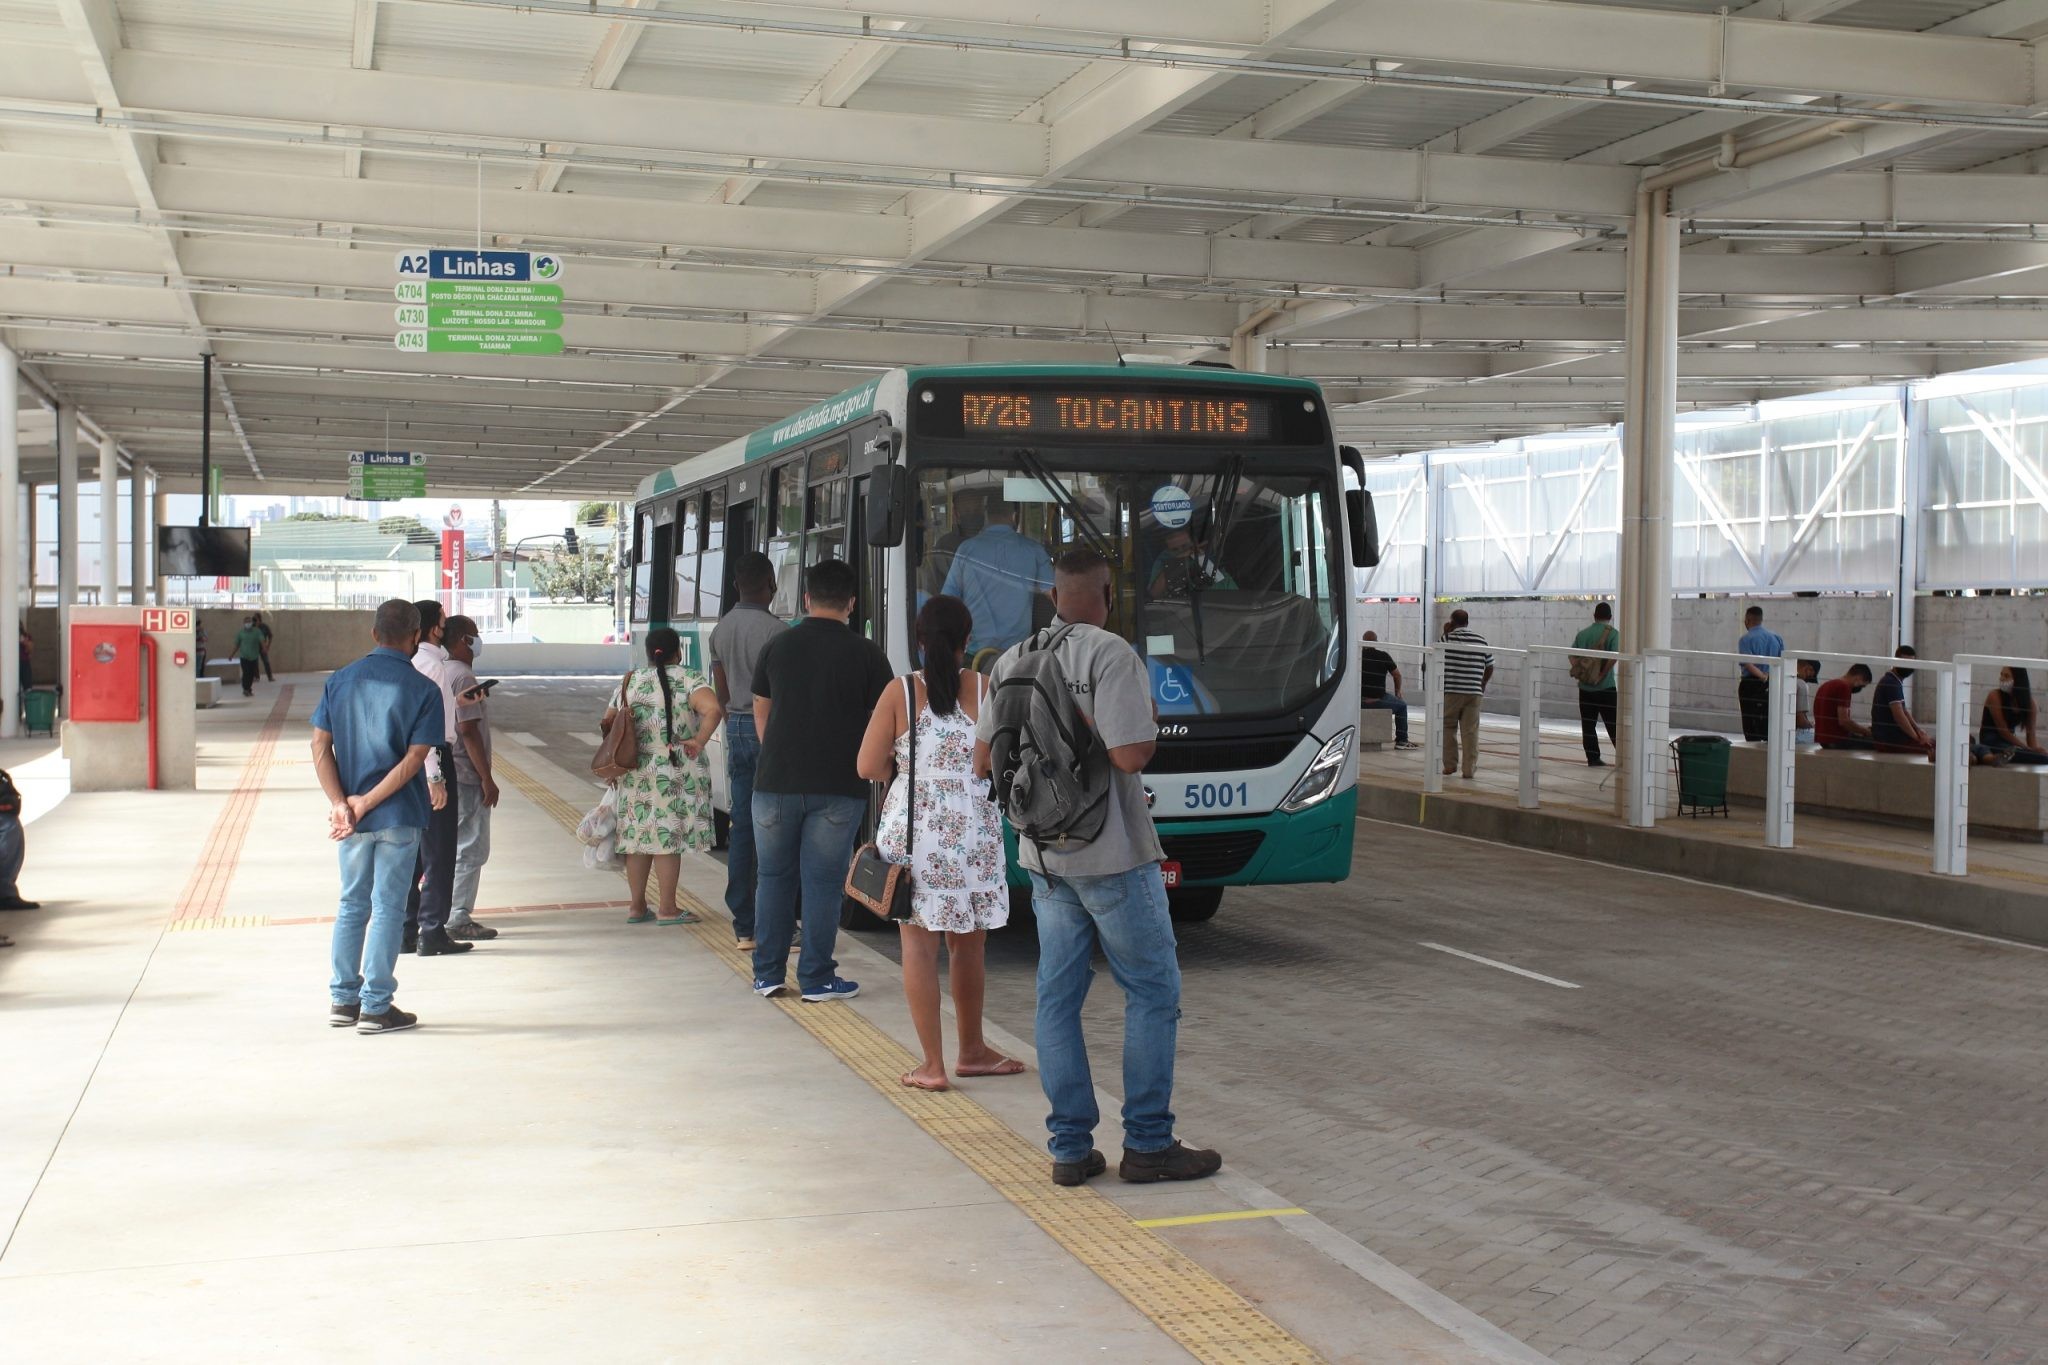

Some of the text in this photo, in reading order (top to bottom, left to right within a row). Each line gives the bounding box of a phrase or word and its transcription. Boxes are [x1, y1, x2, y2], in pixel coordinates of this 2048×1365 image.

[400, 256, 516, 276] A2 Linhas
[398, 285, 422, 298] A704
[521, 295, 557, 303] MARAVILHA)
[399, 310, 424, 323] A730
[399, 334, 424, 348] A743
[772, 385, 874, 446] www.uberlandia.mg.gov.br
[963, 395, 1248, 432] A726 TOCANTINS
[351, 454, 404, 463] A3 Linhas
[146, 611, 163, 630] H
[1157, 724, 1188, 736] olo
[1184, 782, 1247, 808] 5001
